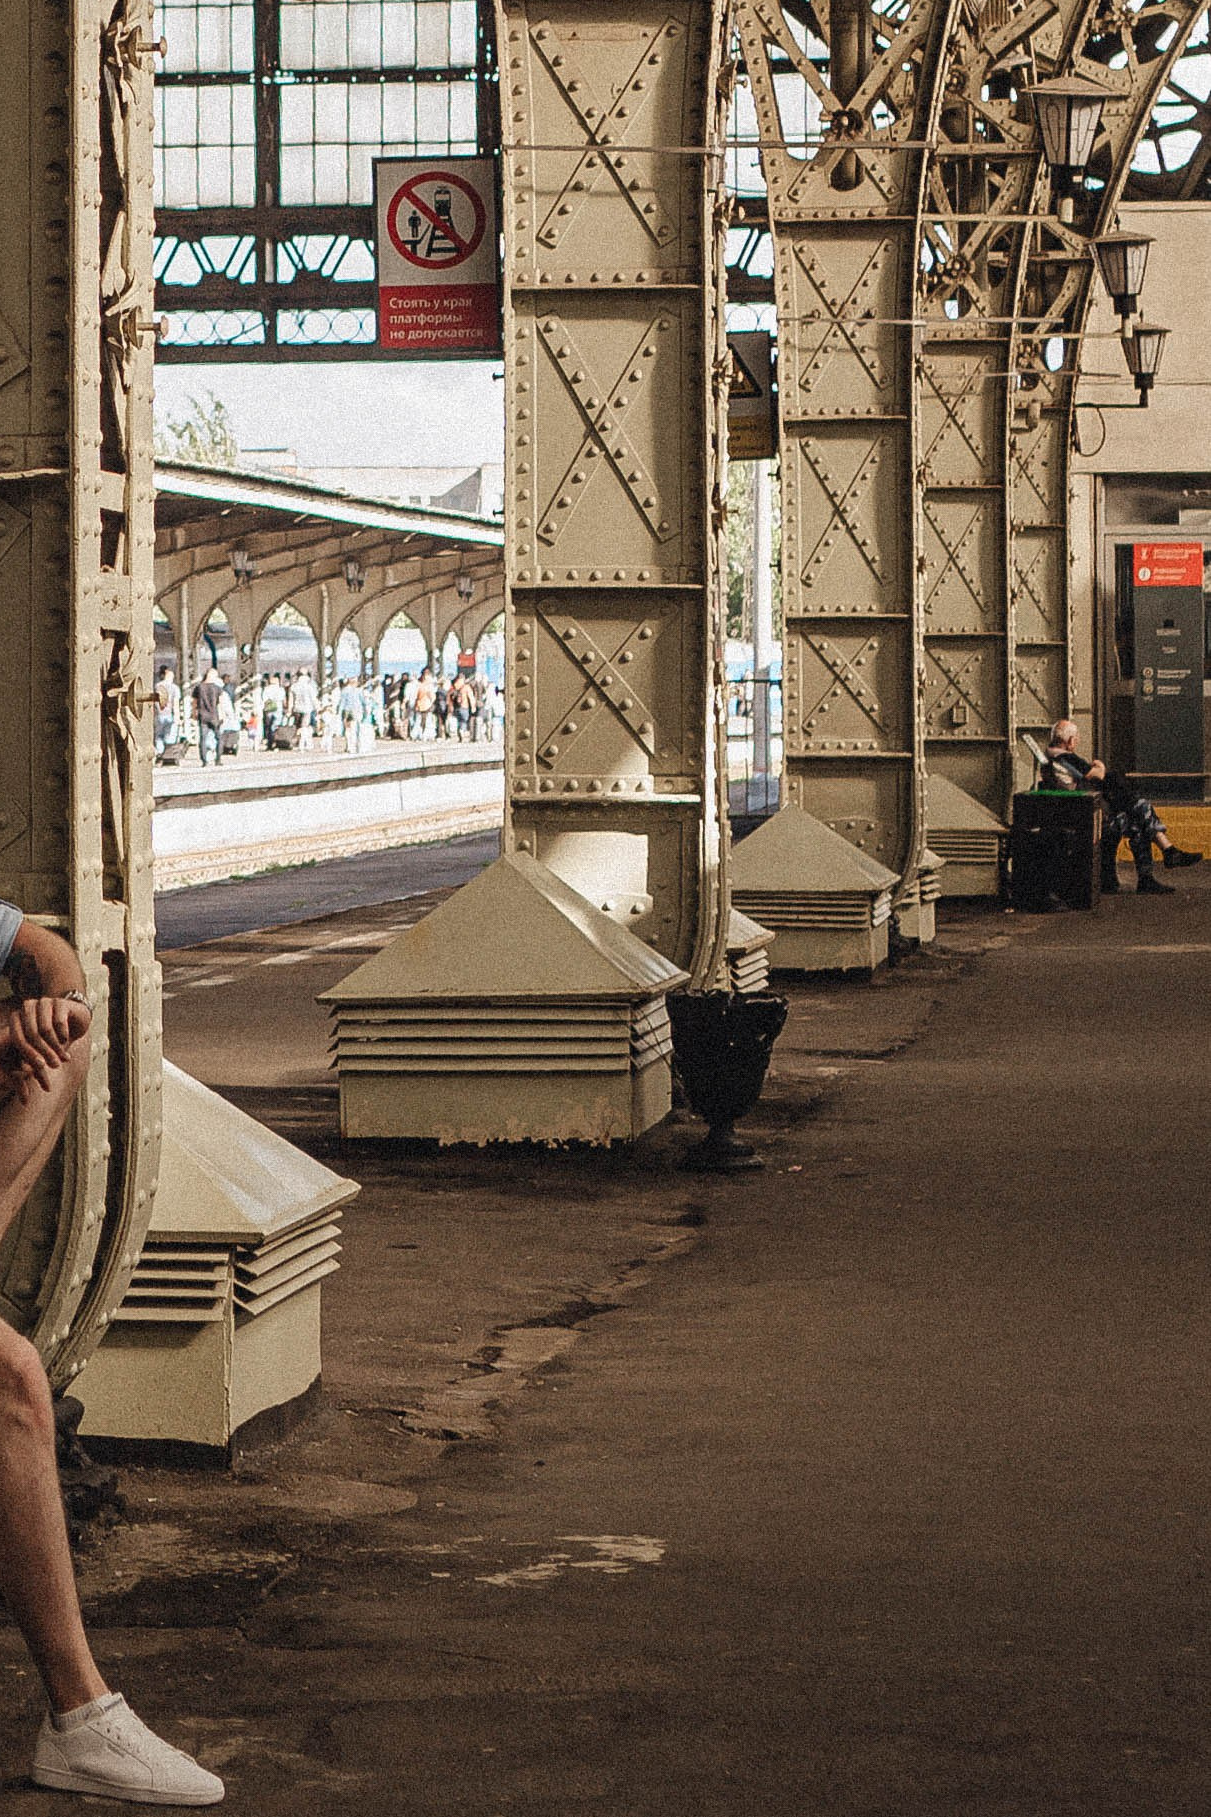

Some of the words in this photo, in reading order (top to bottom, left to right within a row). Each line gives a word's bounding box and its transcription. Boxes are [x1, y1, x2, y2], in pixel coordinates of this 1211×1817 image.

[389, 297, 431, 309] Стоять
[433, 298, 440, 310] у
[443, 297, 472, 310] края
[389, 312, 463, 325] платформы
[389, 330, 405, 340] не
[407, 328, 484, 341] допускается
